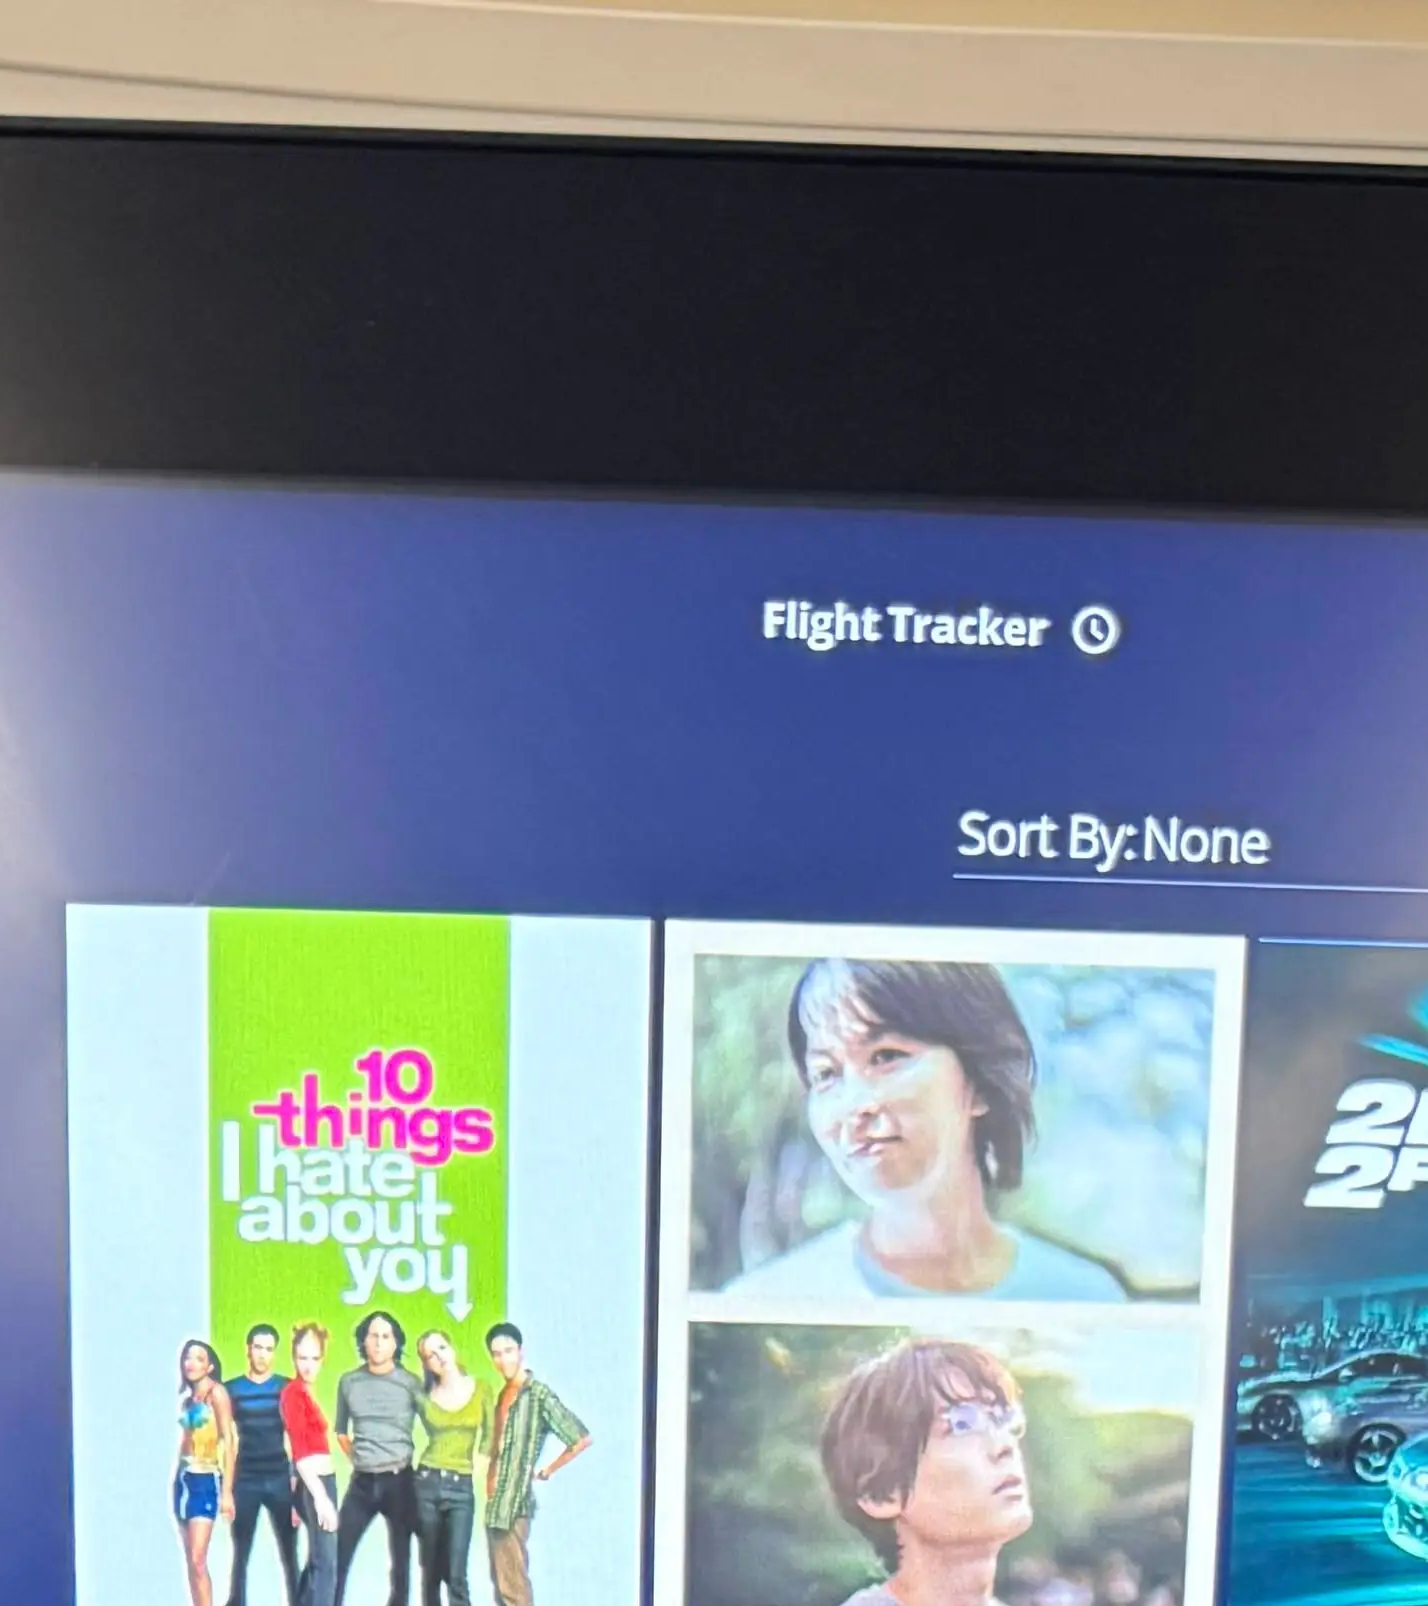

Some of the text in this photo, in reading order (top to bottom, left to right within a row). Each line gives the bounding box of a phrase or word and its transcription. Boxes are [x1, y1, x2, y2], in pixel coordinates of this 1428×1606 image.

[764, 601, 1051, 651] Flight Tracker
[958, 811, 1058, 858] Sort
[356, 1049, 434, 1105] 10
[253, 1073, 494, 1165] things
[220, 1120, 416, 1202] I hate
[238, 1171, 452, 1246] about
[340, 1244, 471, 1321] you
